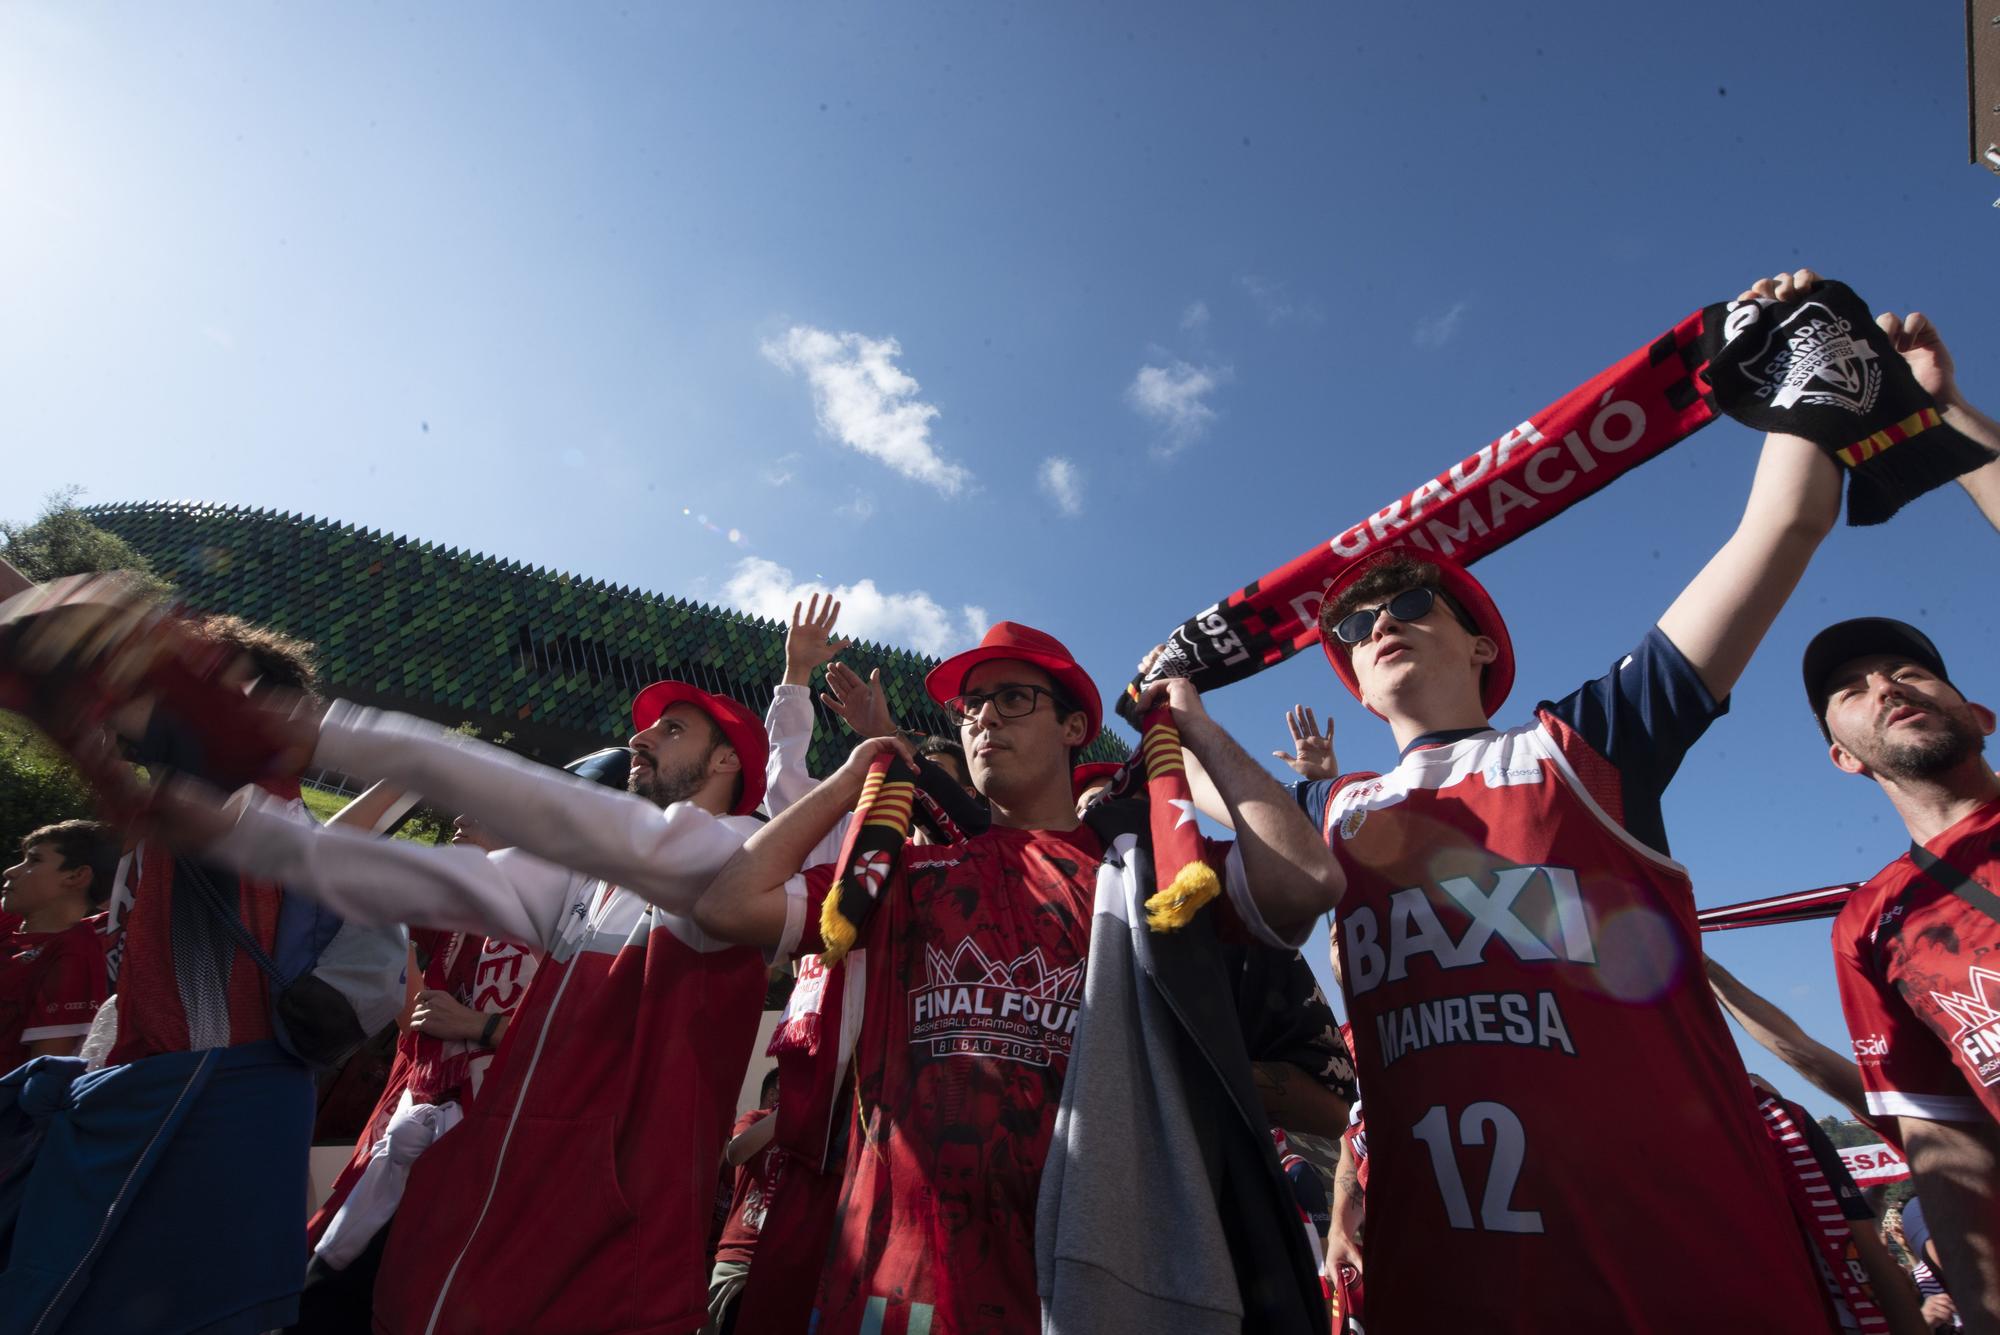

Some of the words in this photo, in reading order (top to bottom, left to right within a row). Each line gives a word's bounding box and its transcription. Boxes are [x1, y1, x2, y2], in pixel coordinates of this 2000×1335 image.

[1765, 318, 1828, 375] GRADA
[1330, 420, 1546, 559] GRADA
[1196, 602, 1250, 667] 1931
[1343, 866, 1596, 998] BAXI
[913, 1016, 967, 1034] BASKETBALL
[969, 1017, 1039, 1036] CHAMPIONS
[915, 987, 993, 1022] FINAL
[1376, 992, 1576, 1068] MANRESA
[939, 1039, 992, 1051] BILBAO
[1001, 1042, 1043, 1061] 2022
[1851, 1033, 1889, 1056] said
[1412, 1101, 1545, 1233] 12
